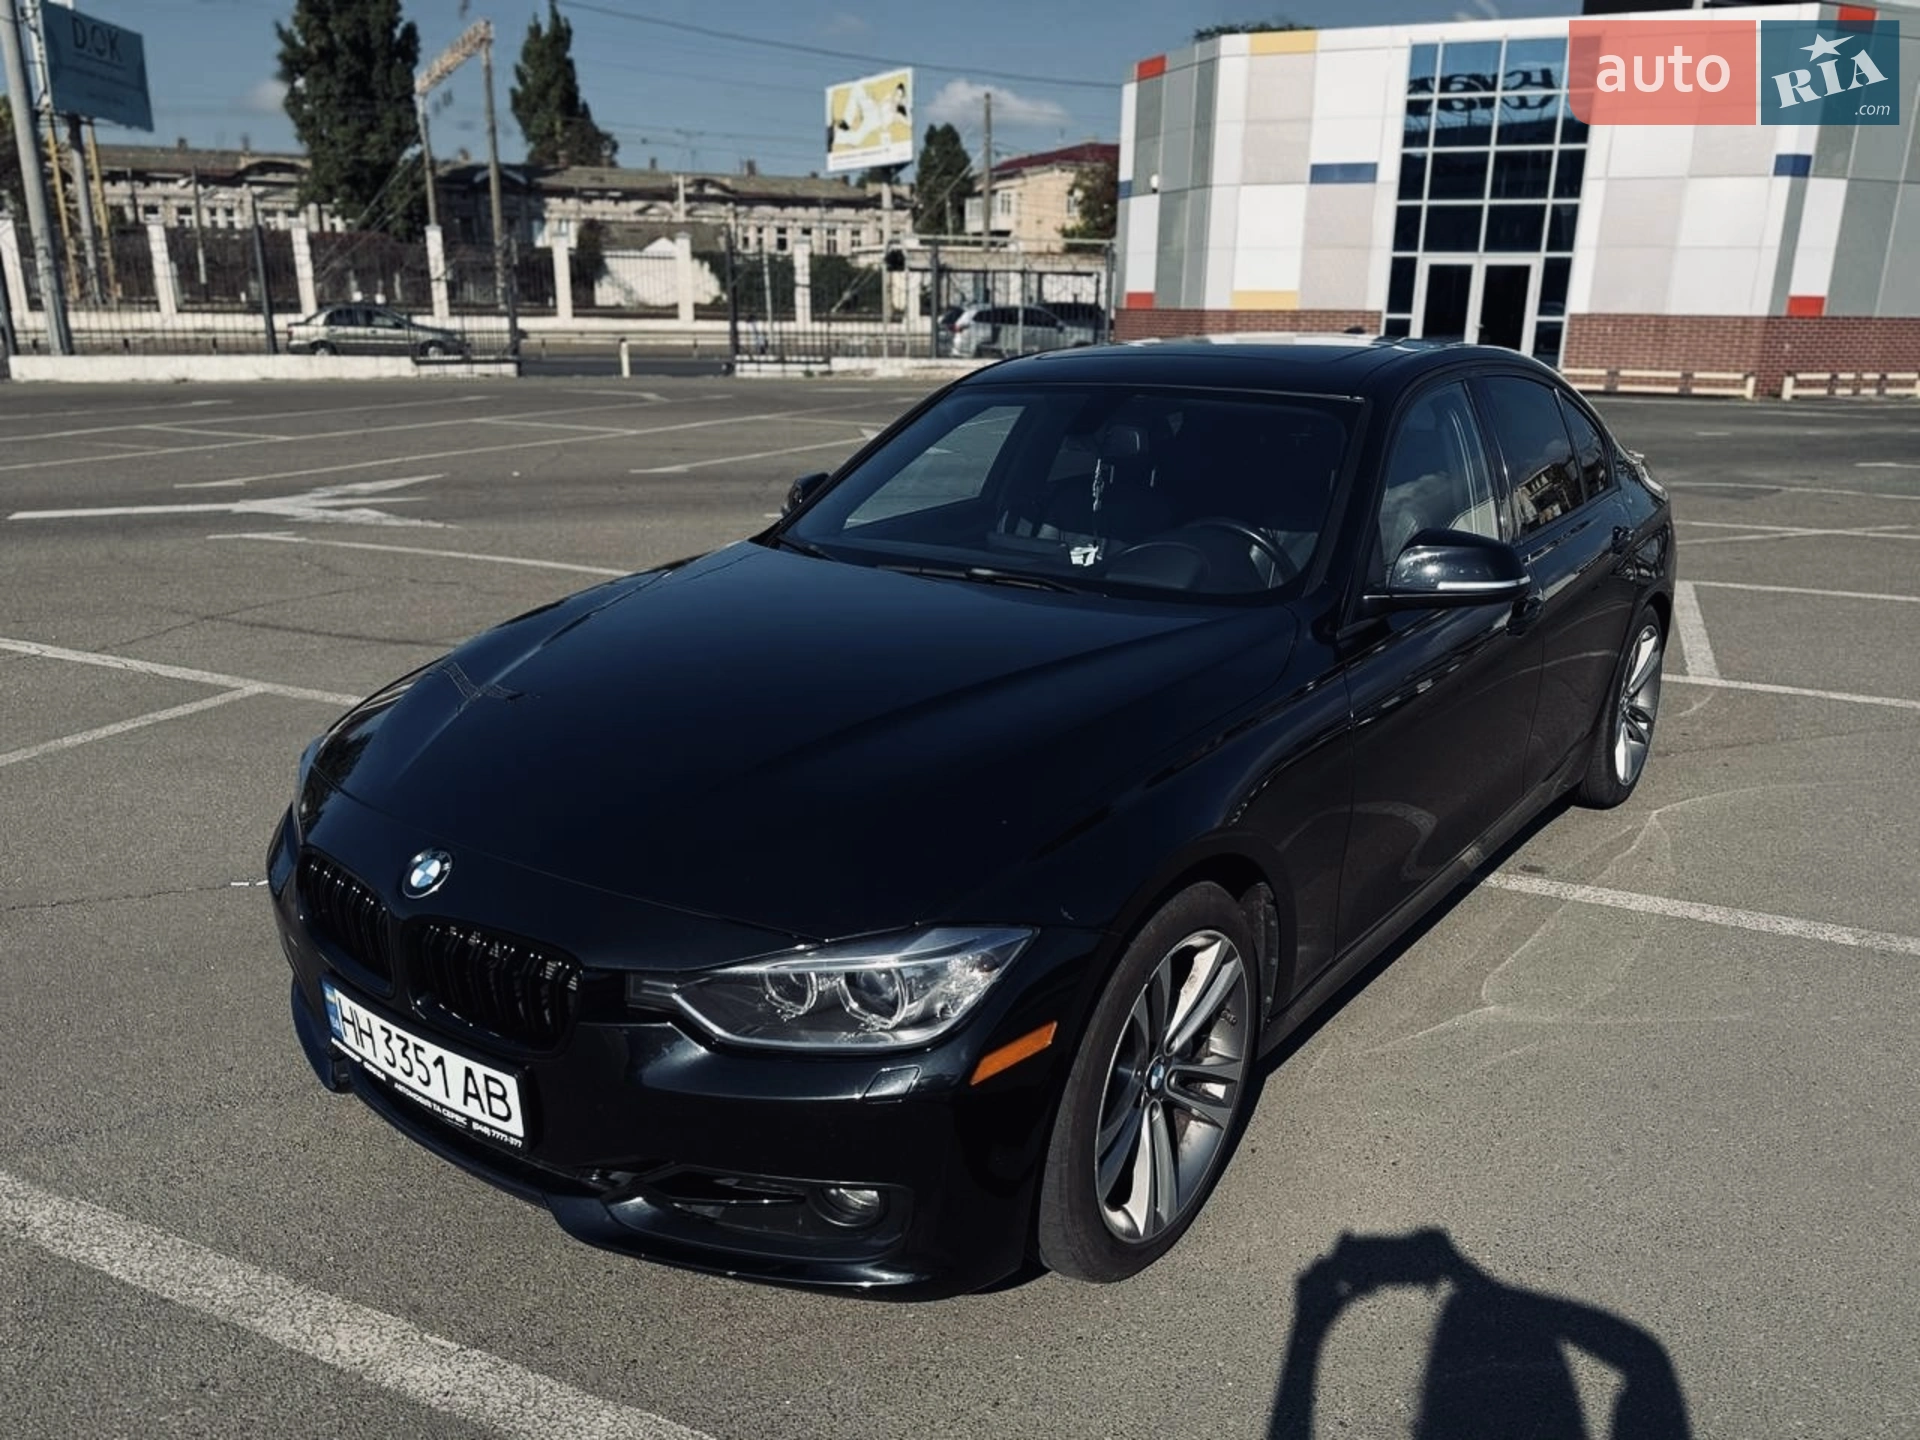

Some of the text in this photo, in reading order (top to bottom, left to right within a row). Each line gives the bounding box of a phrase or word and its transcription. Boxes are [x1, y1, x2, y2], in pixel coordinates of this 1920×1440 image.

[337, 997, 377, 1059] HH
[380, 1026, 450, 1099] 3351
[463, 1065, 512, 1123] AB
